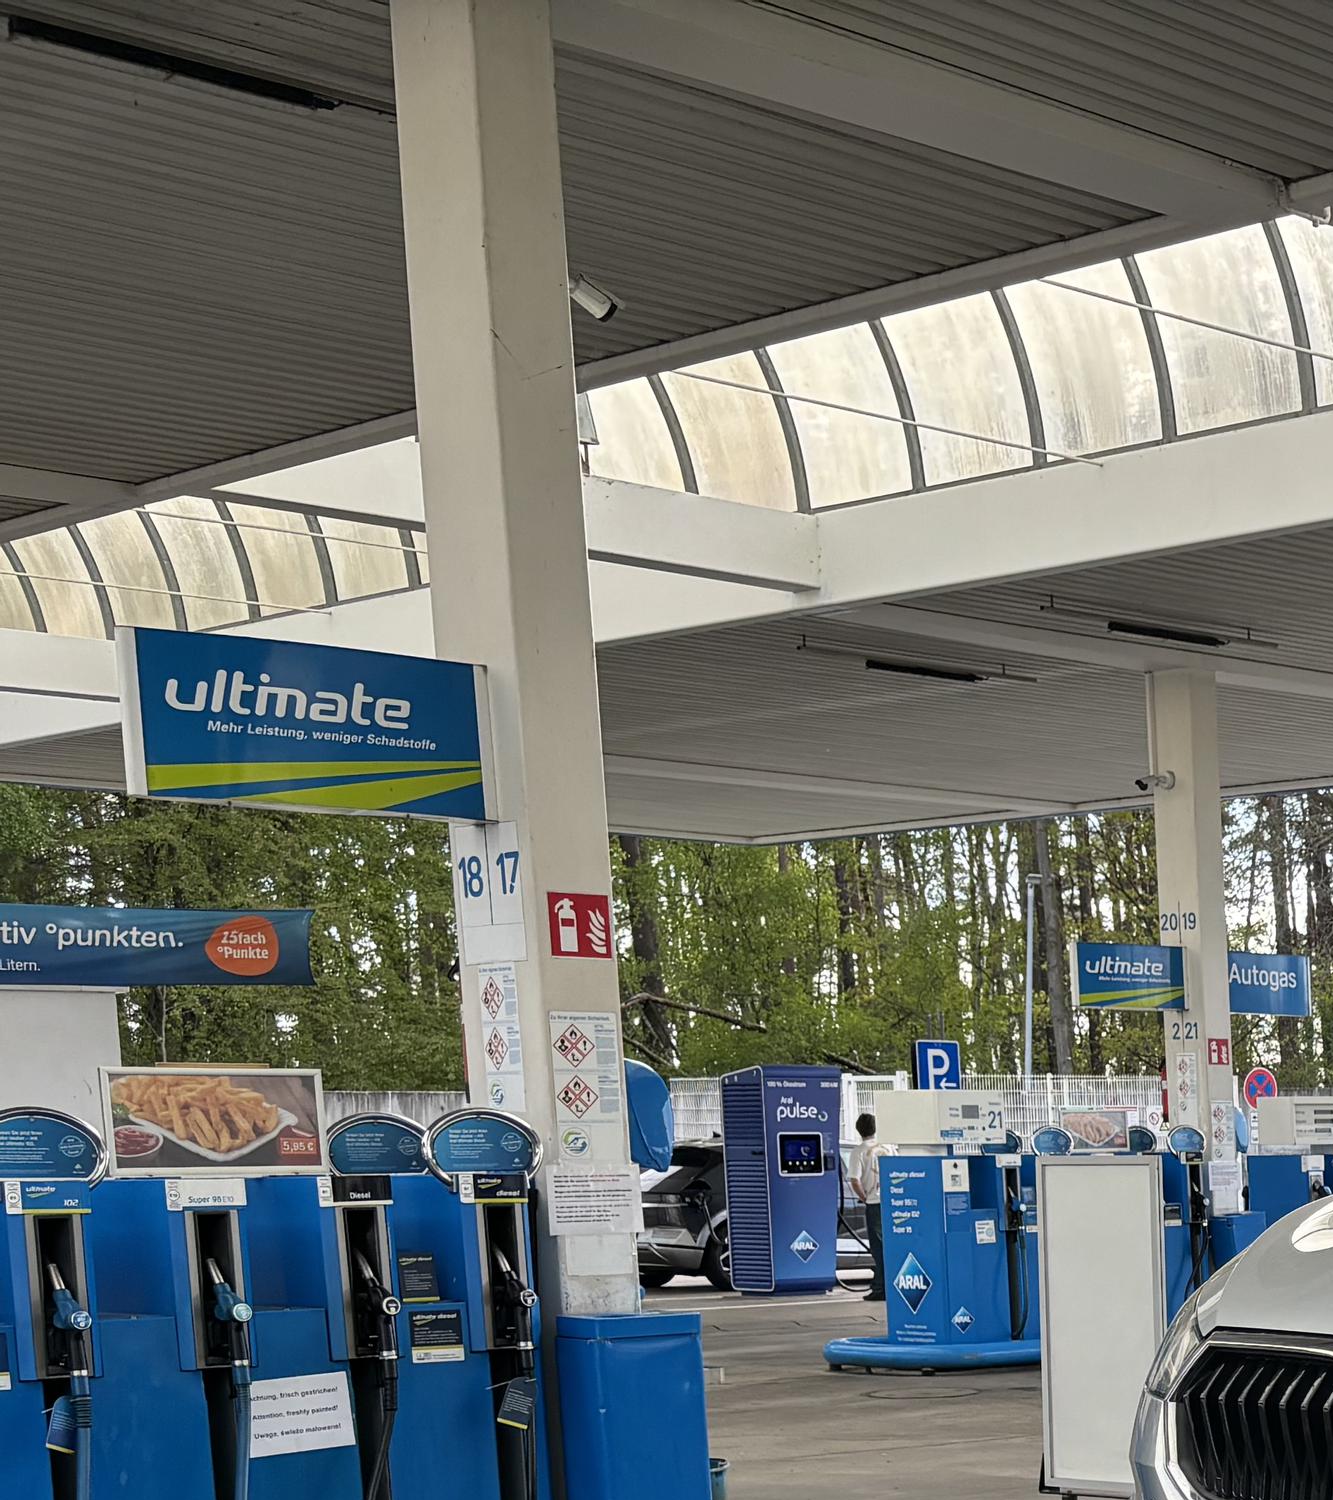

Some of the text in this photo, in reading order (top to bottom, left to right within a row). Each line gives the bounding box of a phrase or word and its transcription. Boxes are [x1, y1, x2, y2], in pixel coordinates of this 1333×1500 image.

[164, 669, 411, 730] ultimate
[207, 720, 437, 751] Mehr Leistung, weniger Schadstoffe
[458, 855, 484, 898] 18
[1160, 913, 1178, 931] 20
[1182, 912, 1196, 930] 19
[221, 930, 266, 945] 15fach
[1085, 956, 1164, 976] ultimate
[1229, 963, 1297, 991] Autogas
[1184, 1022, 1199, 1040] 21
[927, 1048, 950, 1090] P
[780, 1096, 793, 1104] Aral
[777, 1102, 818, 1122] pulse
[988, 1110, 1003, 1129] 21
[350, 1191, 371, 1199] Diesel
[793, 1240, 815, 1250] ARAL
[899, 1274, 927, 1290] ARAL
[954, 1315, 971, 1323] ARAL
